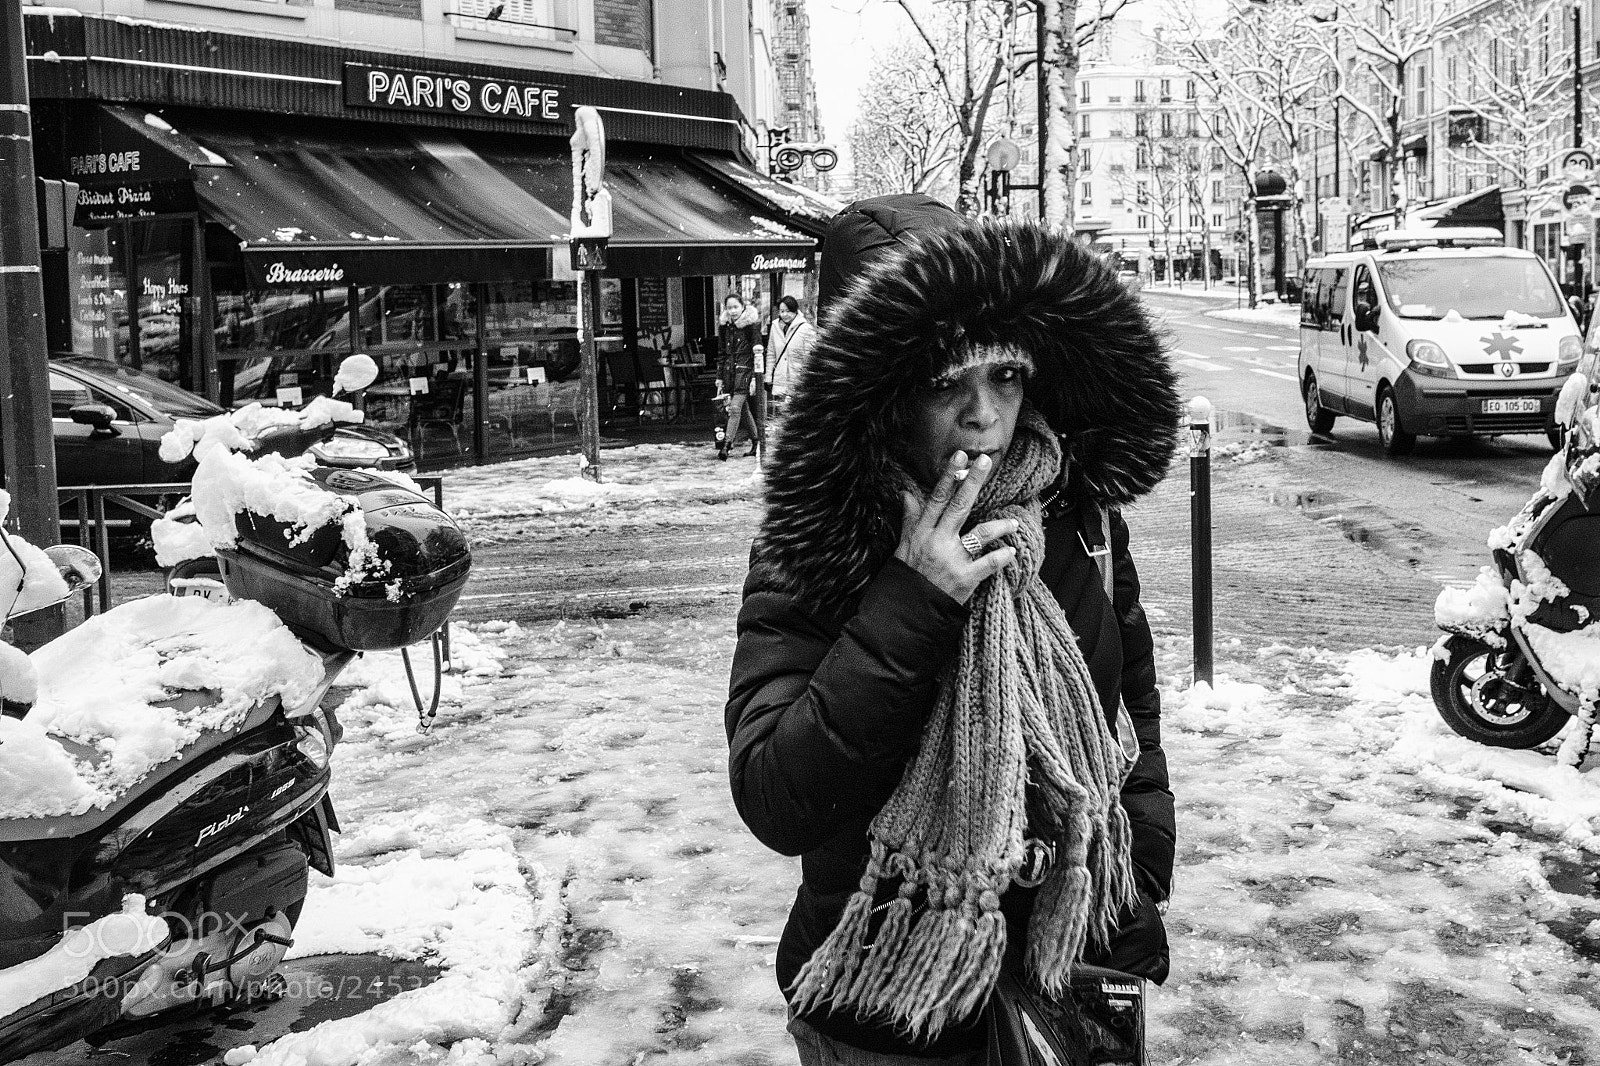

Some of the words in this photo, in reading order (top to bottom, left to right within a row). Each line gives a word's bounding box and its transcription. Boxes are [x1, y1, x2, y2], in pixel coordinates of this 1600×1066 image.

[368, 71, 471, 111] PARI'S
[481, 82, 559, 119] CAFE
[71, 154, 107, 175] PARI'S
[108, 151, 140, 172] CAFE
[78, 189, 114, 205] Bistrot
[118, 187, 151, 204] Pizza
[751, 253, 806, 270] Restaurant
[266, 262, 344, 283] Brasserie
[143, 277, 165, 299] Happy
[168, 277, 188, 294] Hours
